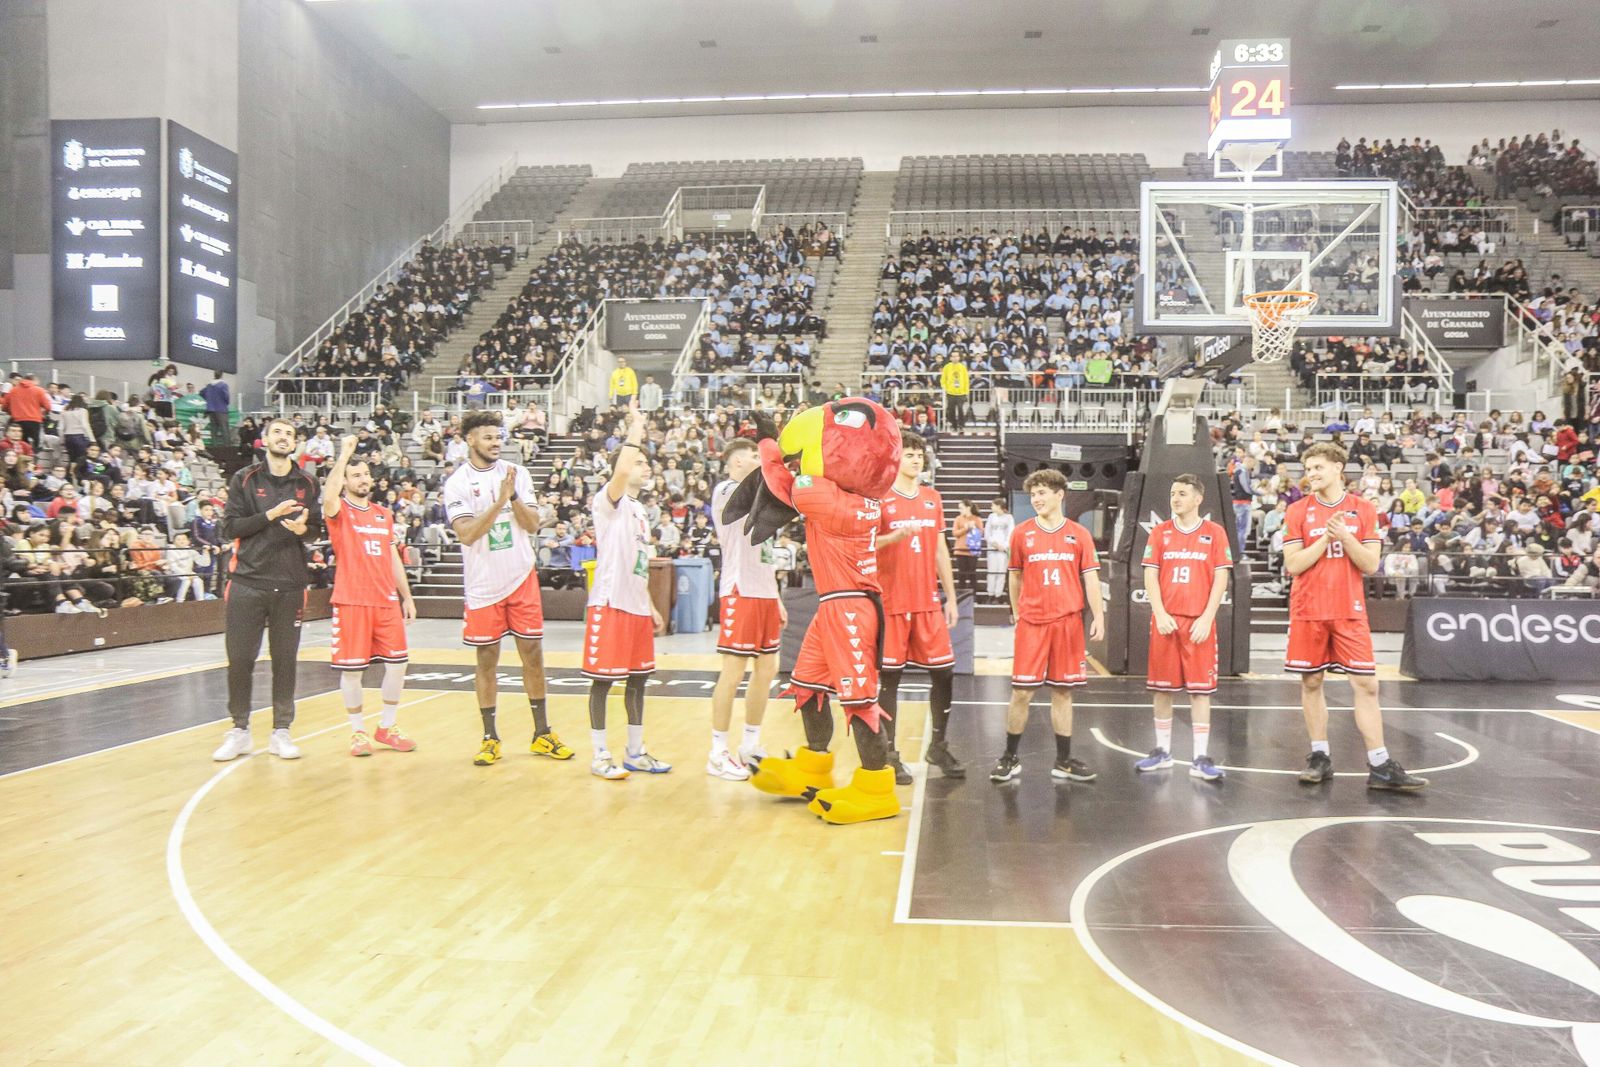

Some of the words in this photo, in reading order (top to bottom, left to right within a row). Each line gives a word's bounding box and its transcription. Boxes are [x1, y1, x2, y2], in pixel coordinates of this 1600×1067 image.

[1234, 43, 1284, 63] 6:33
[1230, 79, 1285, 117] 24
[624, 313, 686, 321] AYUNTAMIENTO
[1422, 309, 1490, 318] AYUNTAMIENTO
[641, 322, 681, 330] GRANADA
[1440, 319, 1484, 328] GRANADA
[364, 540, 383, 556] 15
[910, 535, 922, 553] 4
[1326, 541, 1345, 559] 19
[1043, 568, 1062, 586] 14
[1171, 566, 1191, 584] 19
